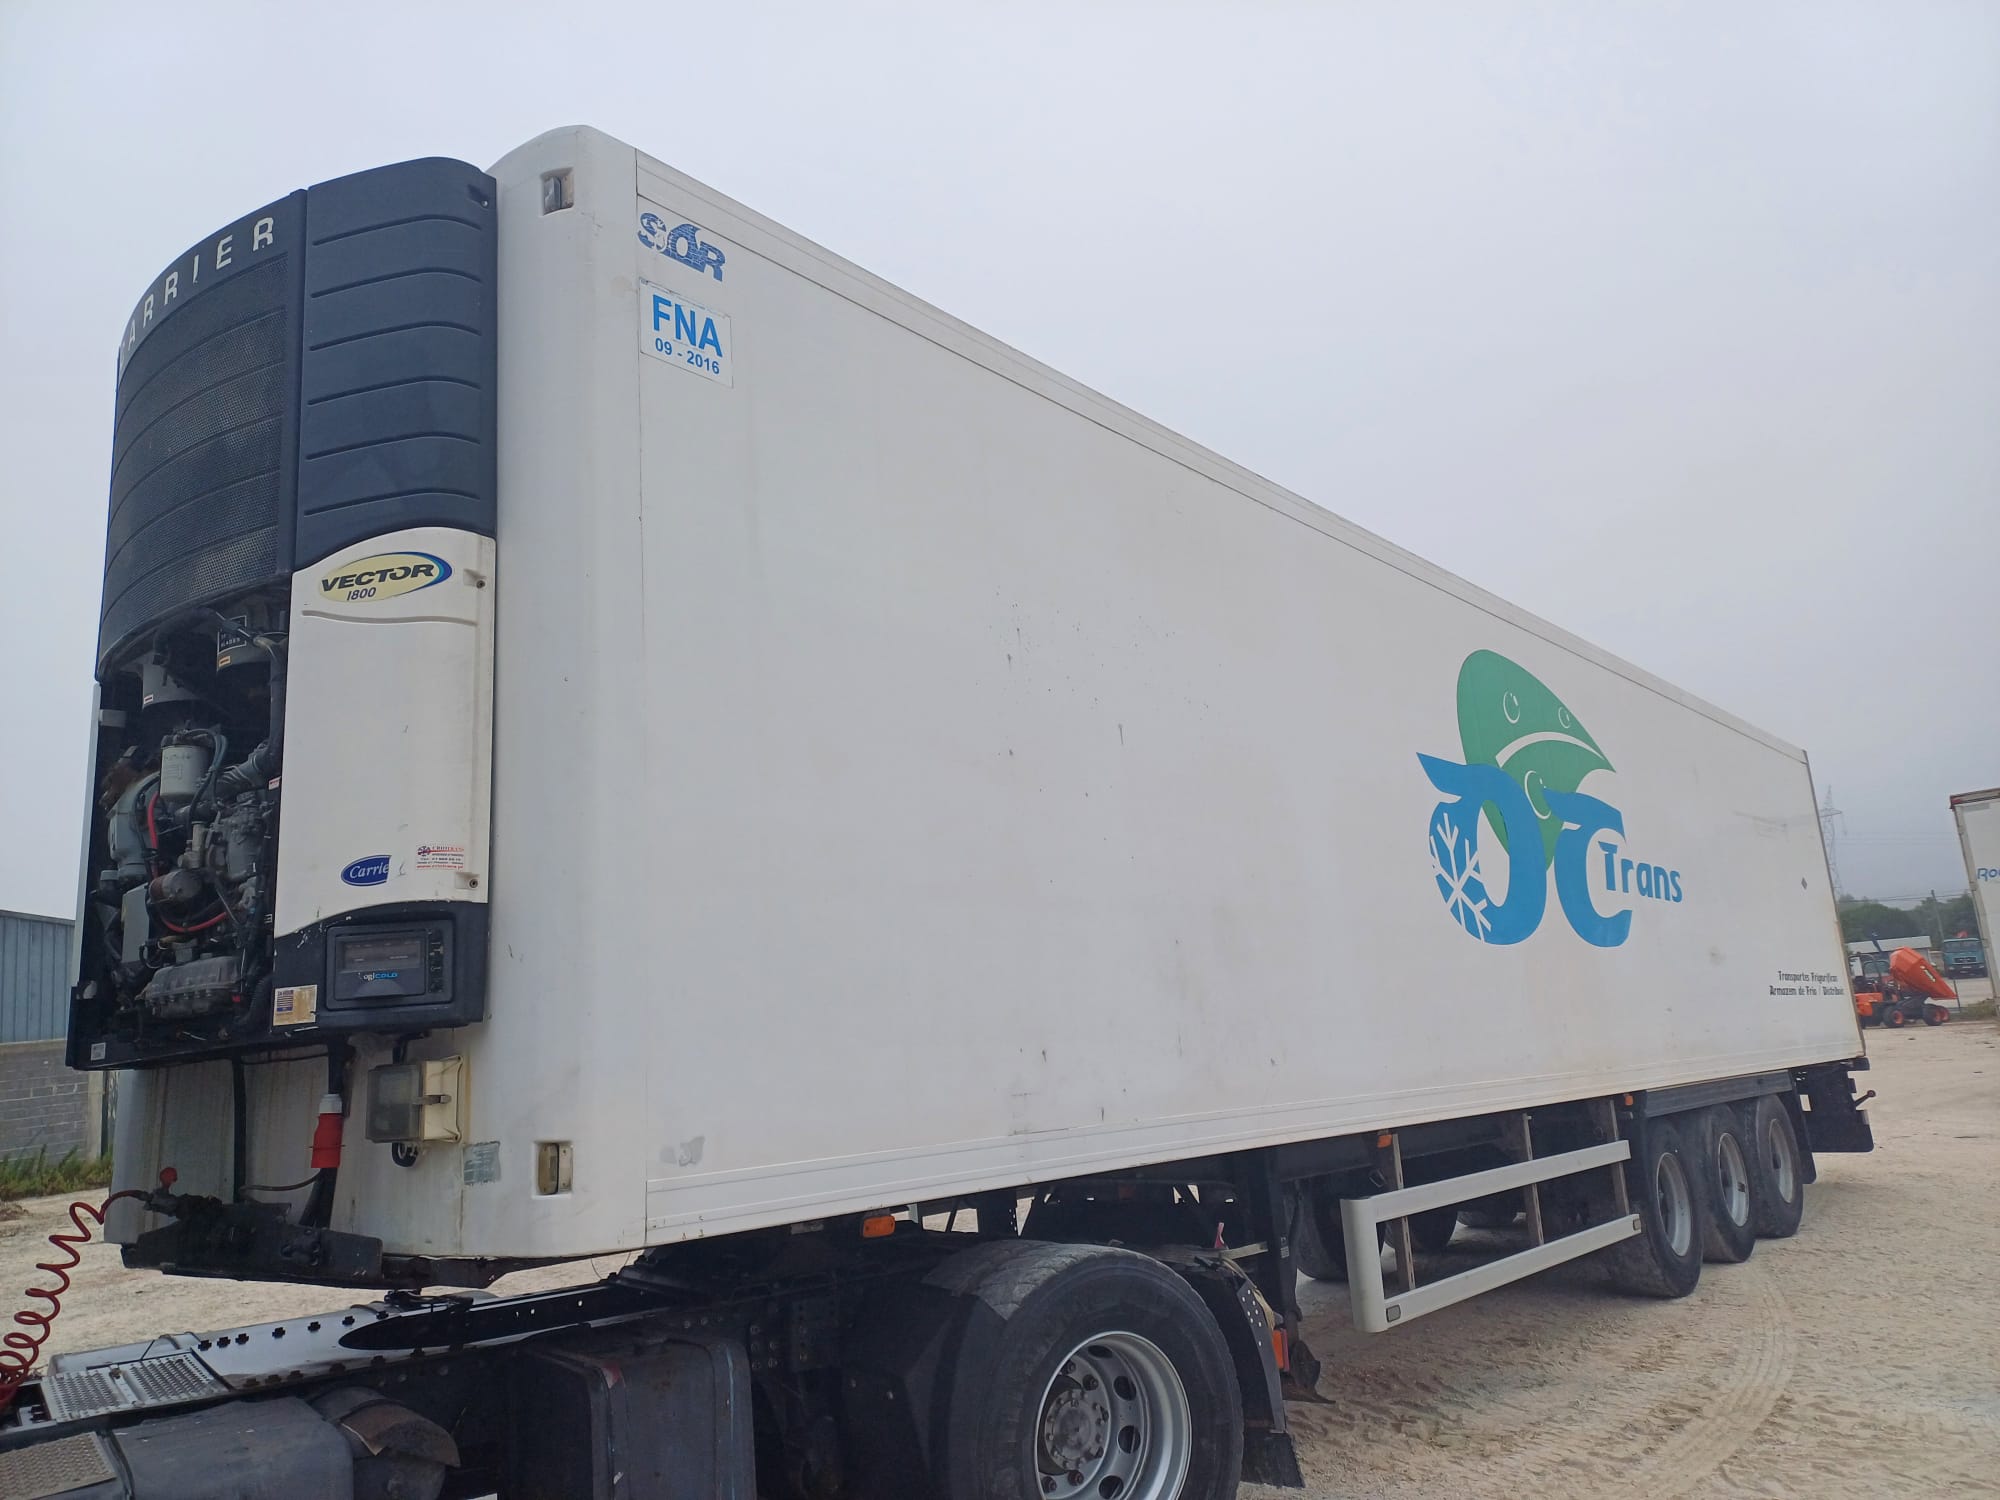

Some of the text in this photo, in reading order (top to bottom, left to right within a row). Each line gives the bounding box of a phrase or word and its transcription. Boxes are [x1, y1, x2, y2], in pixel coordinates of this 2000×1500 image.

[637, 212, 726, 282] SOR
[652, 294, 723, 358] FNA
[655, 337, 673, 356] 09
[687, 350, 720, 375] 2016
[321, 564, 434, 592] VECTOR
[346, 587, 377, 601] 1800
[1598, 841, 1683, 903] Trans
[1977, 867, 2000, 882] Ro
